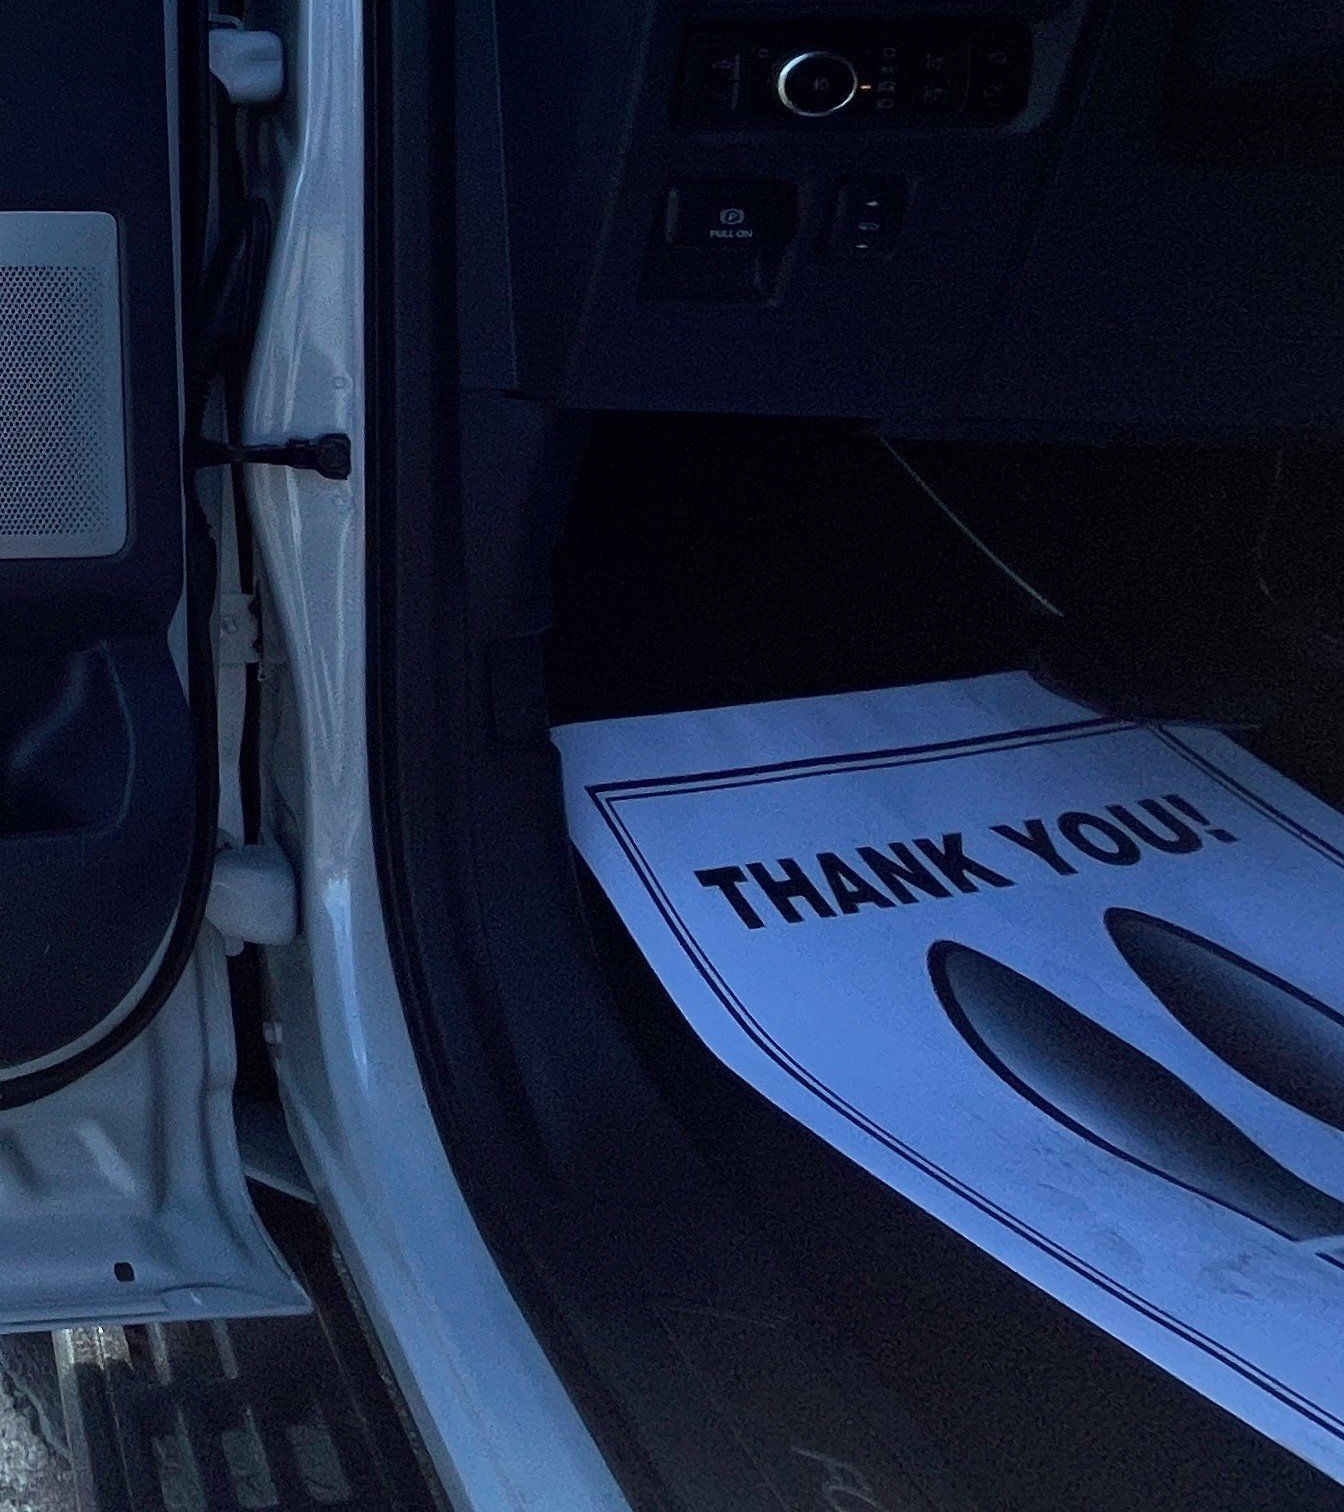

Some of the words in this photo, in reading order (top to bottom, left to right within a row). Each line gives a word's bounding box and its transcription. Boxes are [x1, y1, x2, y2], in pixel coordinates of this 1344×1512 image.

[735, 229, 753, 239] ON
[694, 832, 1017, 930] THANK
[989, 794, 1241, 876] YOU!
